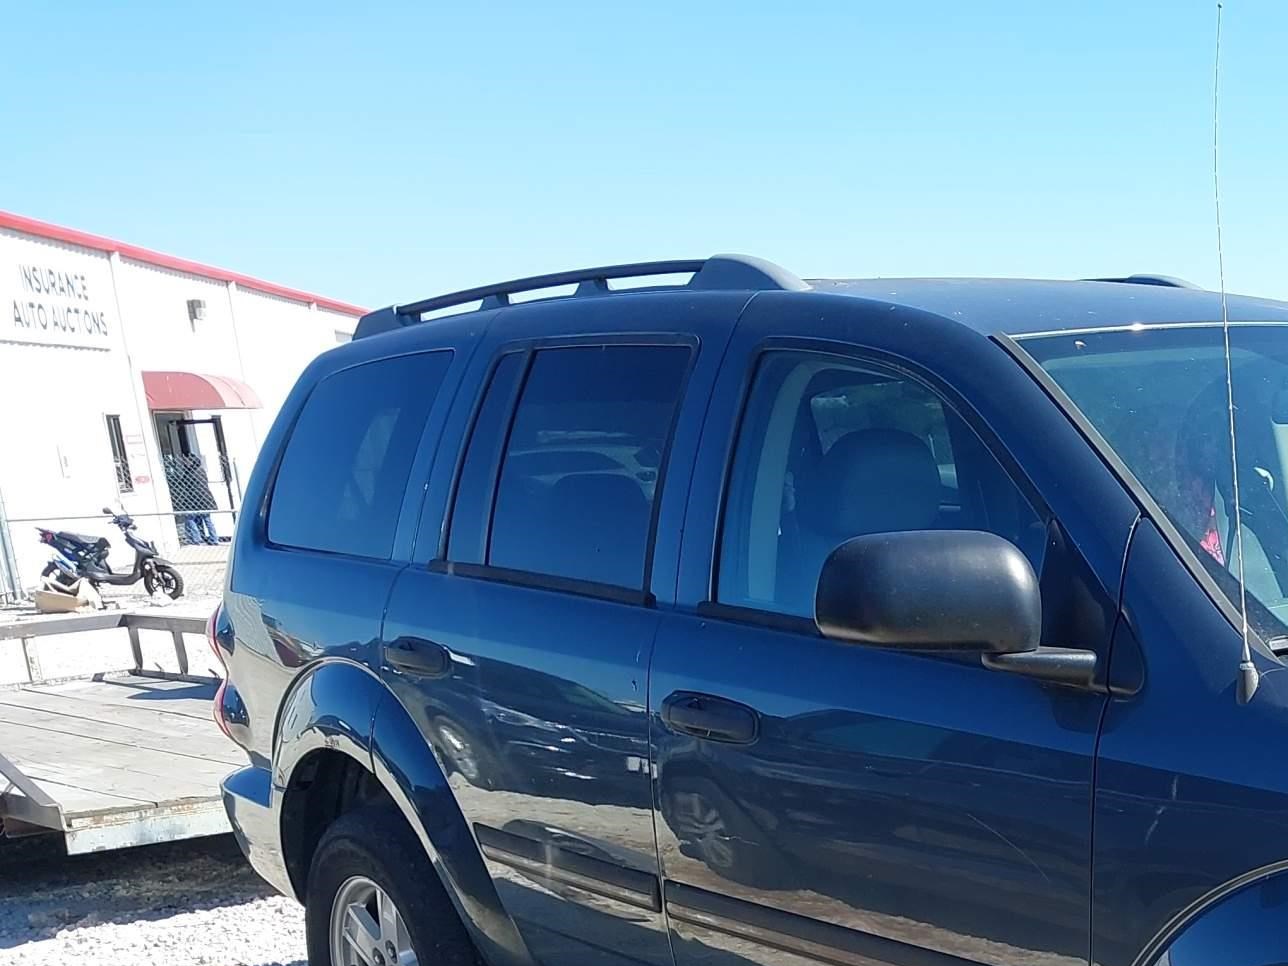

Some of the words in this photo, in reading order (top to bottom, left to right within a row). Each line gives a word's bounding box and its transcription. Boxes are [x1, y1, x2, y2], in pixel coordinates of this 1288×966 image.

[18, 264, 89, 301] INSURANCE
[13, 299, 48, 330] AUTO
[51, 304, 108, 337] AUCTONS
